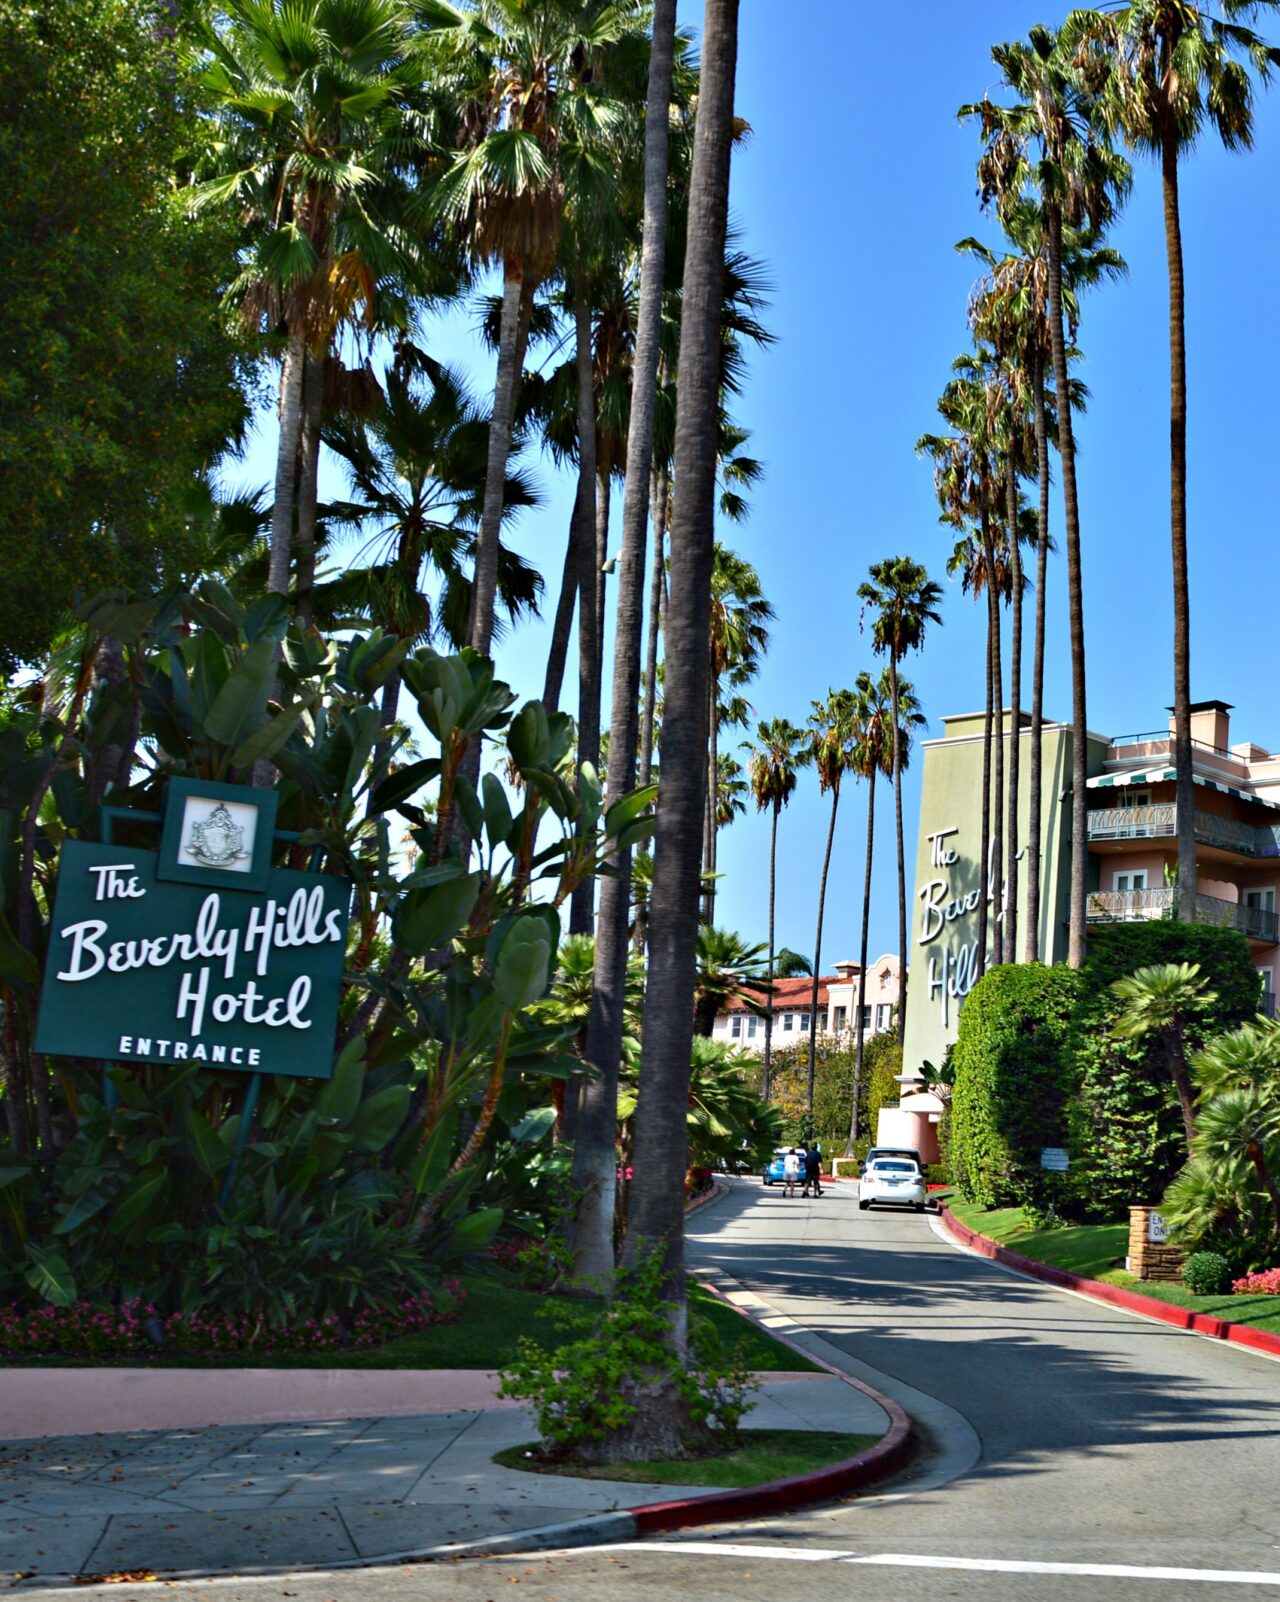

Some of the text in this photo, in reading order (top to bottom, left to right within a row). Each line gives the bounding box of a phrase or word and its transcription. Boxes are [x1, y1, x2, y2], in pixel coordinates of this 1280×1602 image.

[925, 825, 959, 866] The
[88, 864, 146, 900] The
[56, 885, 342, 982] Beverly Hills
[176, 967, 312, 1036] Hotel
[119, 1035, 261, 1065] ENTRANCE
